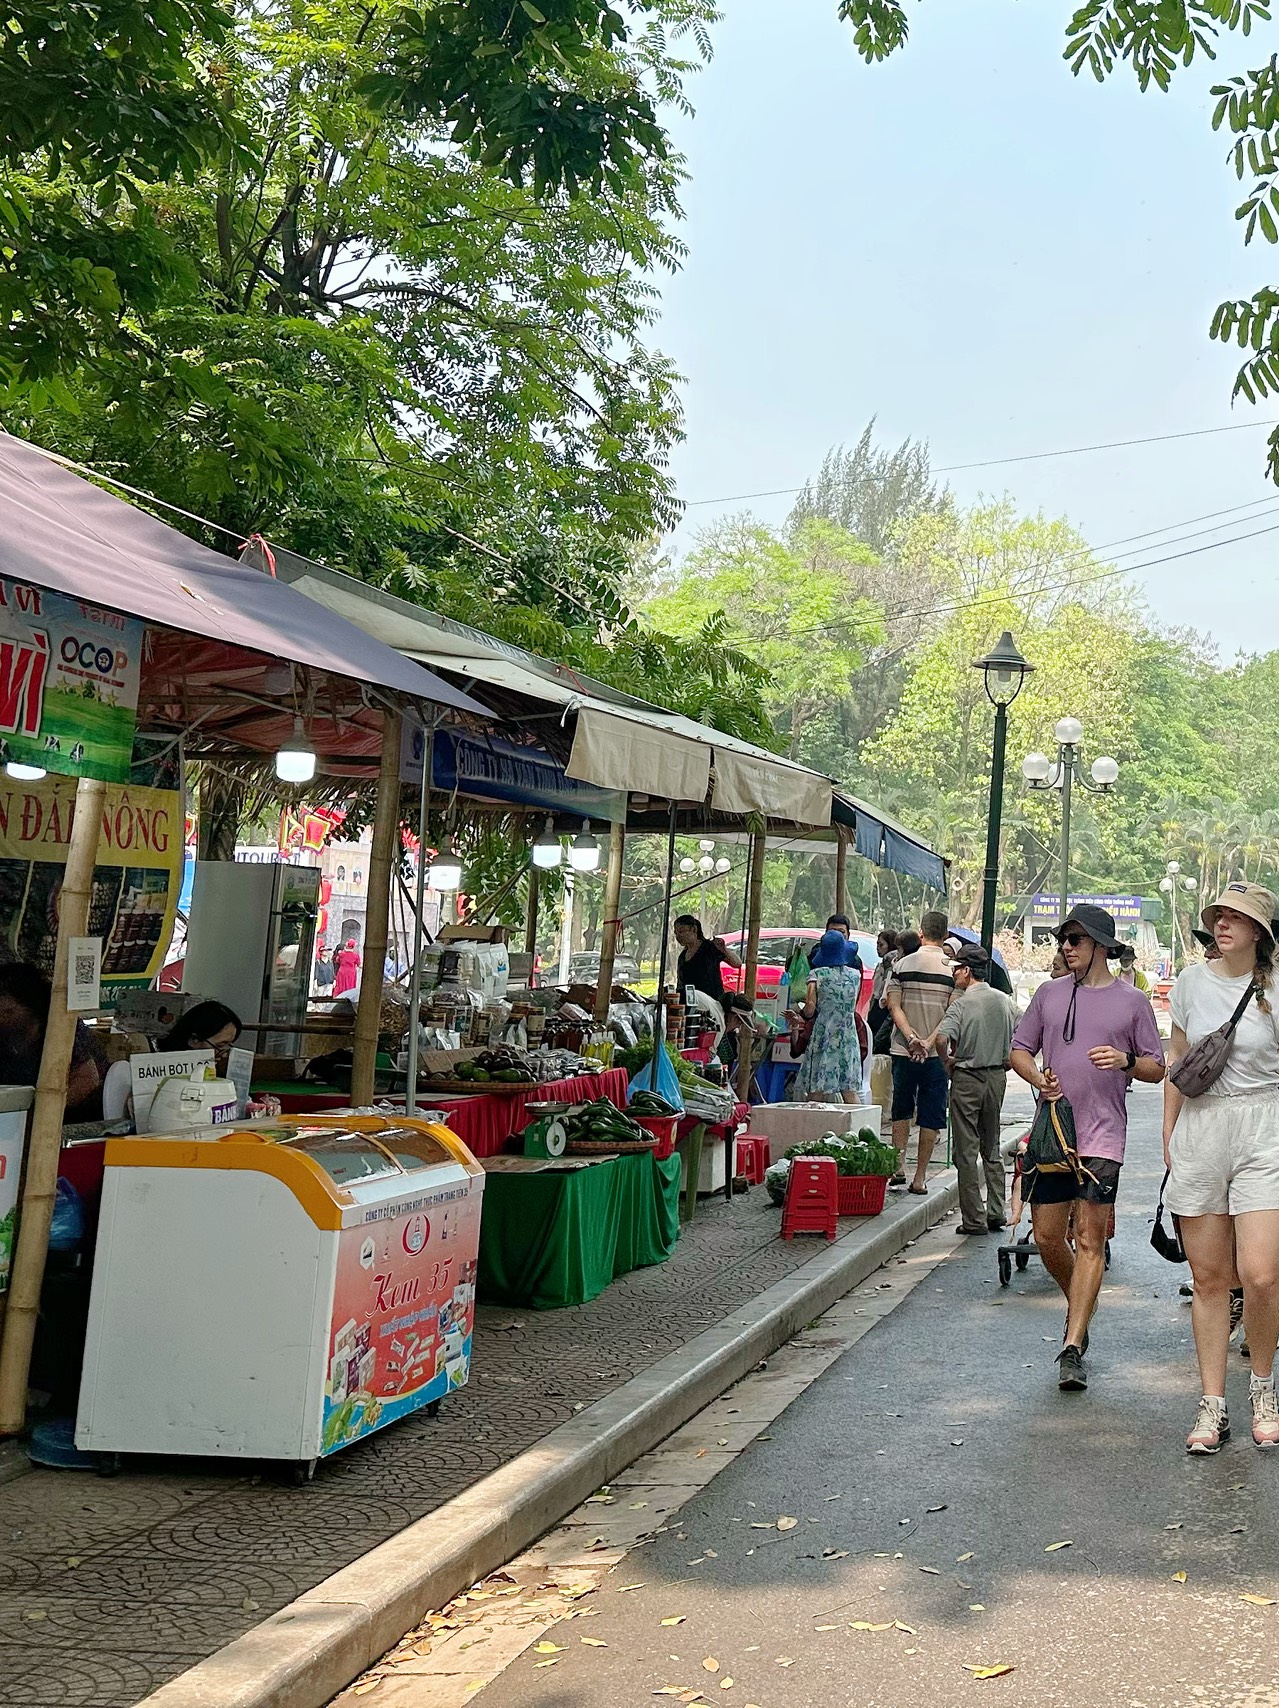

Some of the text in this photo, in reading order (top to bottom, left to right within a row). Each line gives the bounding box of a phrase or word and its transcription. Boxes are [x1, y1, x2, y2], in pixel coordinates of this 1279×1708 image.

[60, 636, 128, 677] OCOP
[103, 790, 169, 852] NÔNG
[365, 1255, 453, 1317] Kem 35
